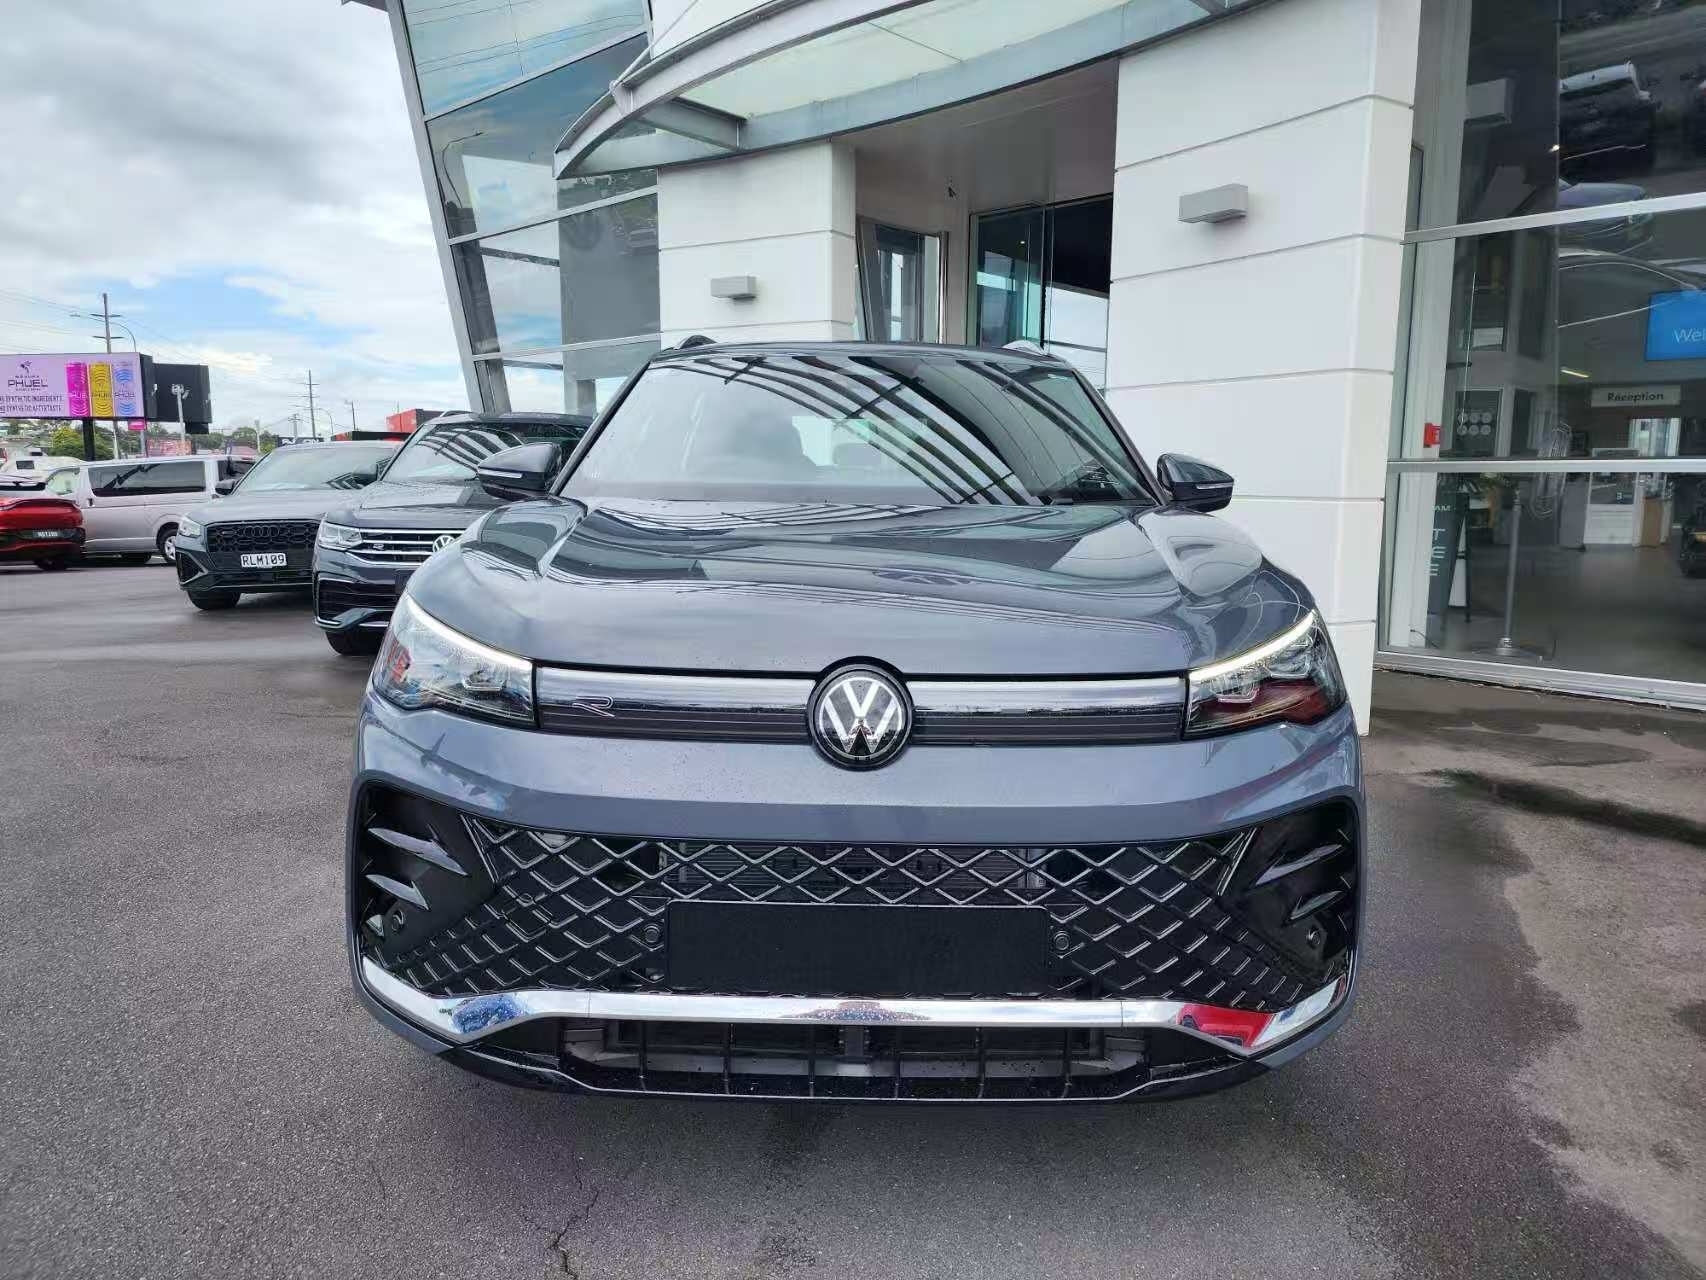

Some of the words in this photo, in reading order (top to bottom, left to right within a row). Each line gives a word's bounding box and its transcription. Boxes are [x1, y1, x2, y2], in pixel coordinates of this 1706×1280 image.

[7, 379, 49, 388] PHUEL
[1607, 391, 1664, 402] Reception
[242, 554, 285, 567] RLM109
